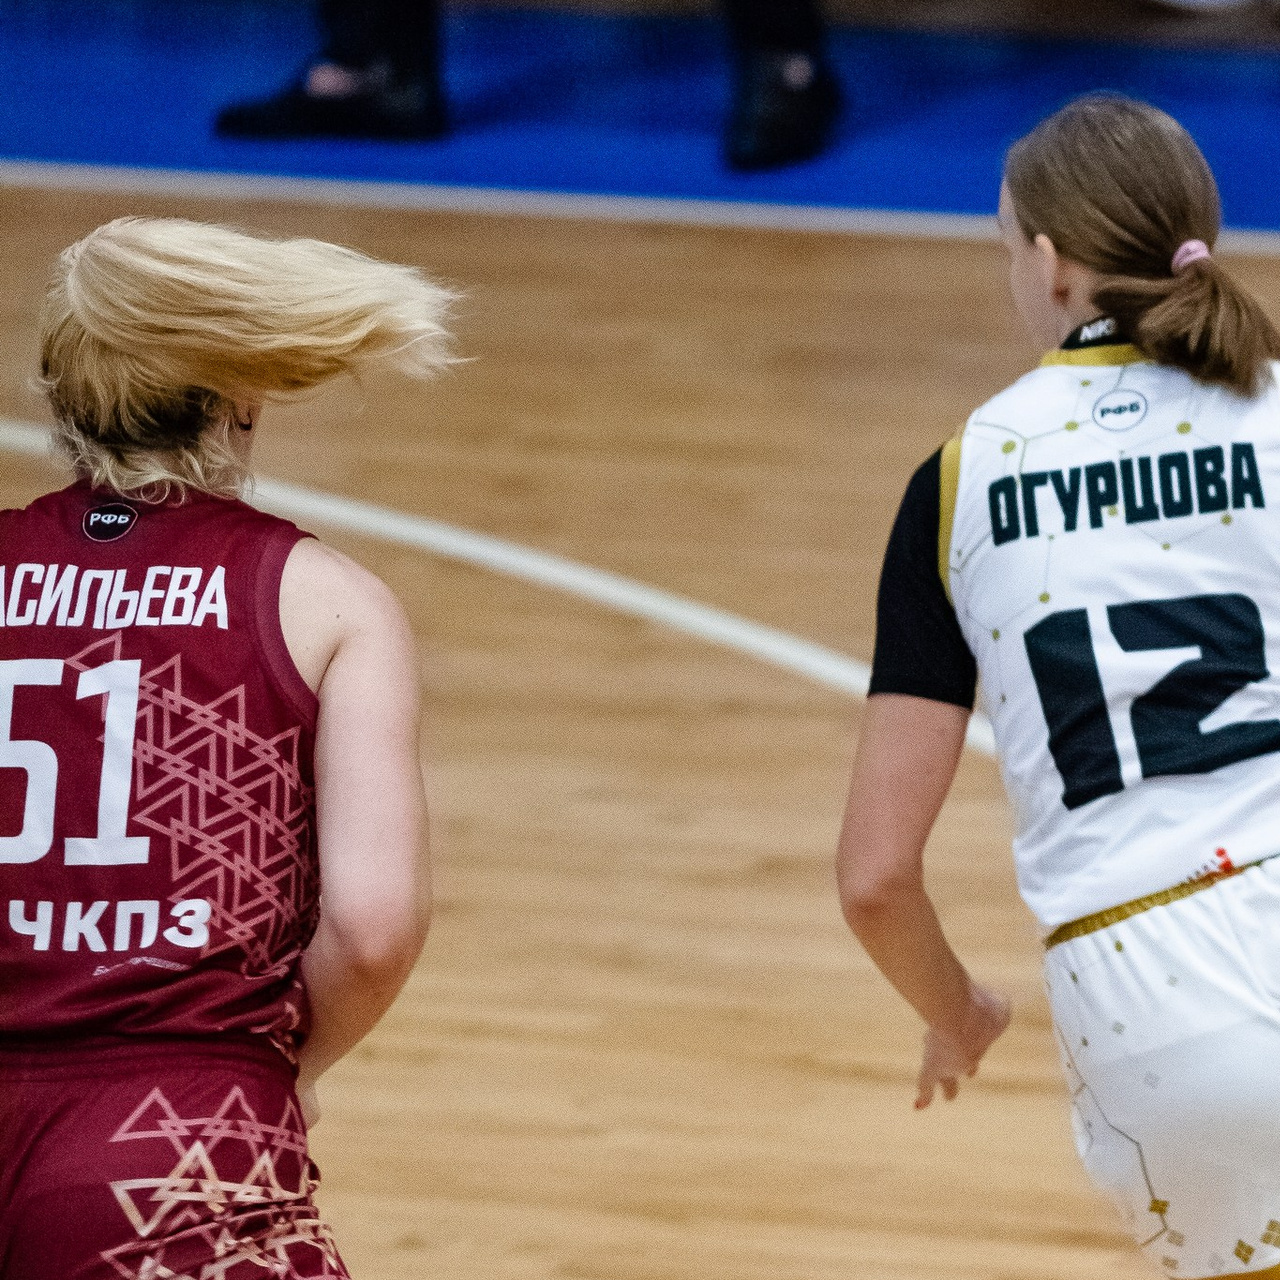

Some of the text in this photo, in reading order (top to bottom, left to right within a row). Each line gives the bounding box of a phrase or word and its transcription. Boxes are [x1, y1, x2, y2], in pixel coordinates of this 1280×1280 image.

[1079, 317, 1117, 342] NIK
[1100, 401, 1140, 418] РФБ
[90, 513, 131, 526] РФБ
[987, 442, 1265, 548] ОГУРЦОВА
[0, 563, 229, 630] СИЛЬЕВА
[0, 658, 150, 866] 51
[8, 898, 212, 952] ЧКПЗ
